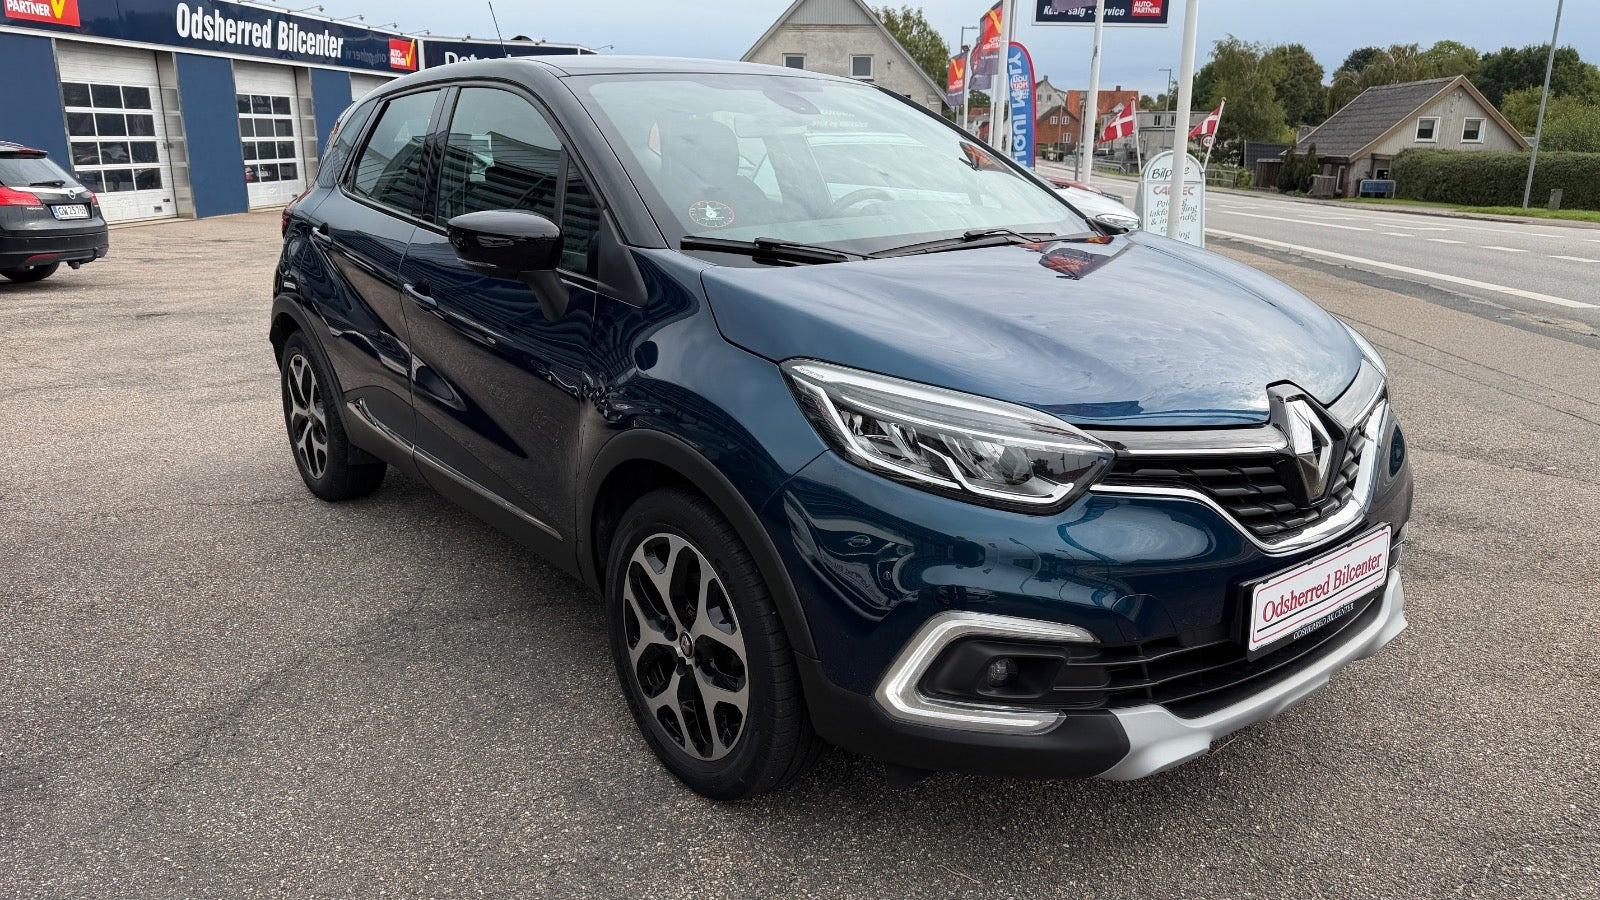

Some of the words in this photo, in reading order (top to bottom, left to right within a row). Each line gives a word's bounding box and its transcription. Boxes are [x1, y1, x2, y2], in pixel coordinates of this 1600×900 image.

[6, 0, 51, 17] PARTNER
[1094, 6, 1126, 16] srvice
[176, 2, 272, 49] Odsherred
[277, 20, 344, 58] Bilcenter
[1262, 574, 1331, 622] Odsherred
[1332, 553, 1383, 591] Bilcenter
